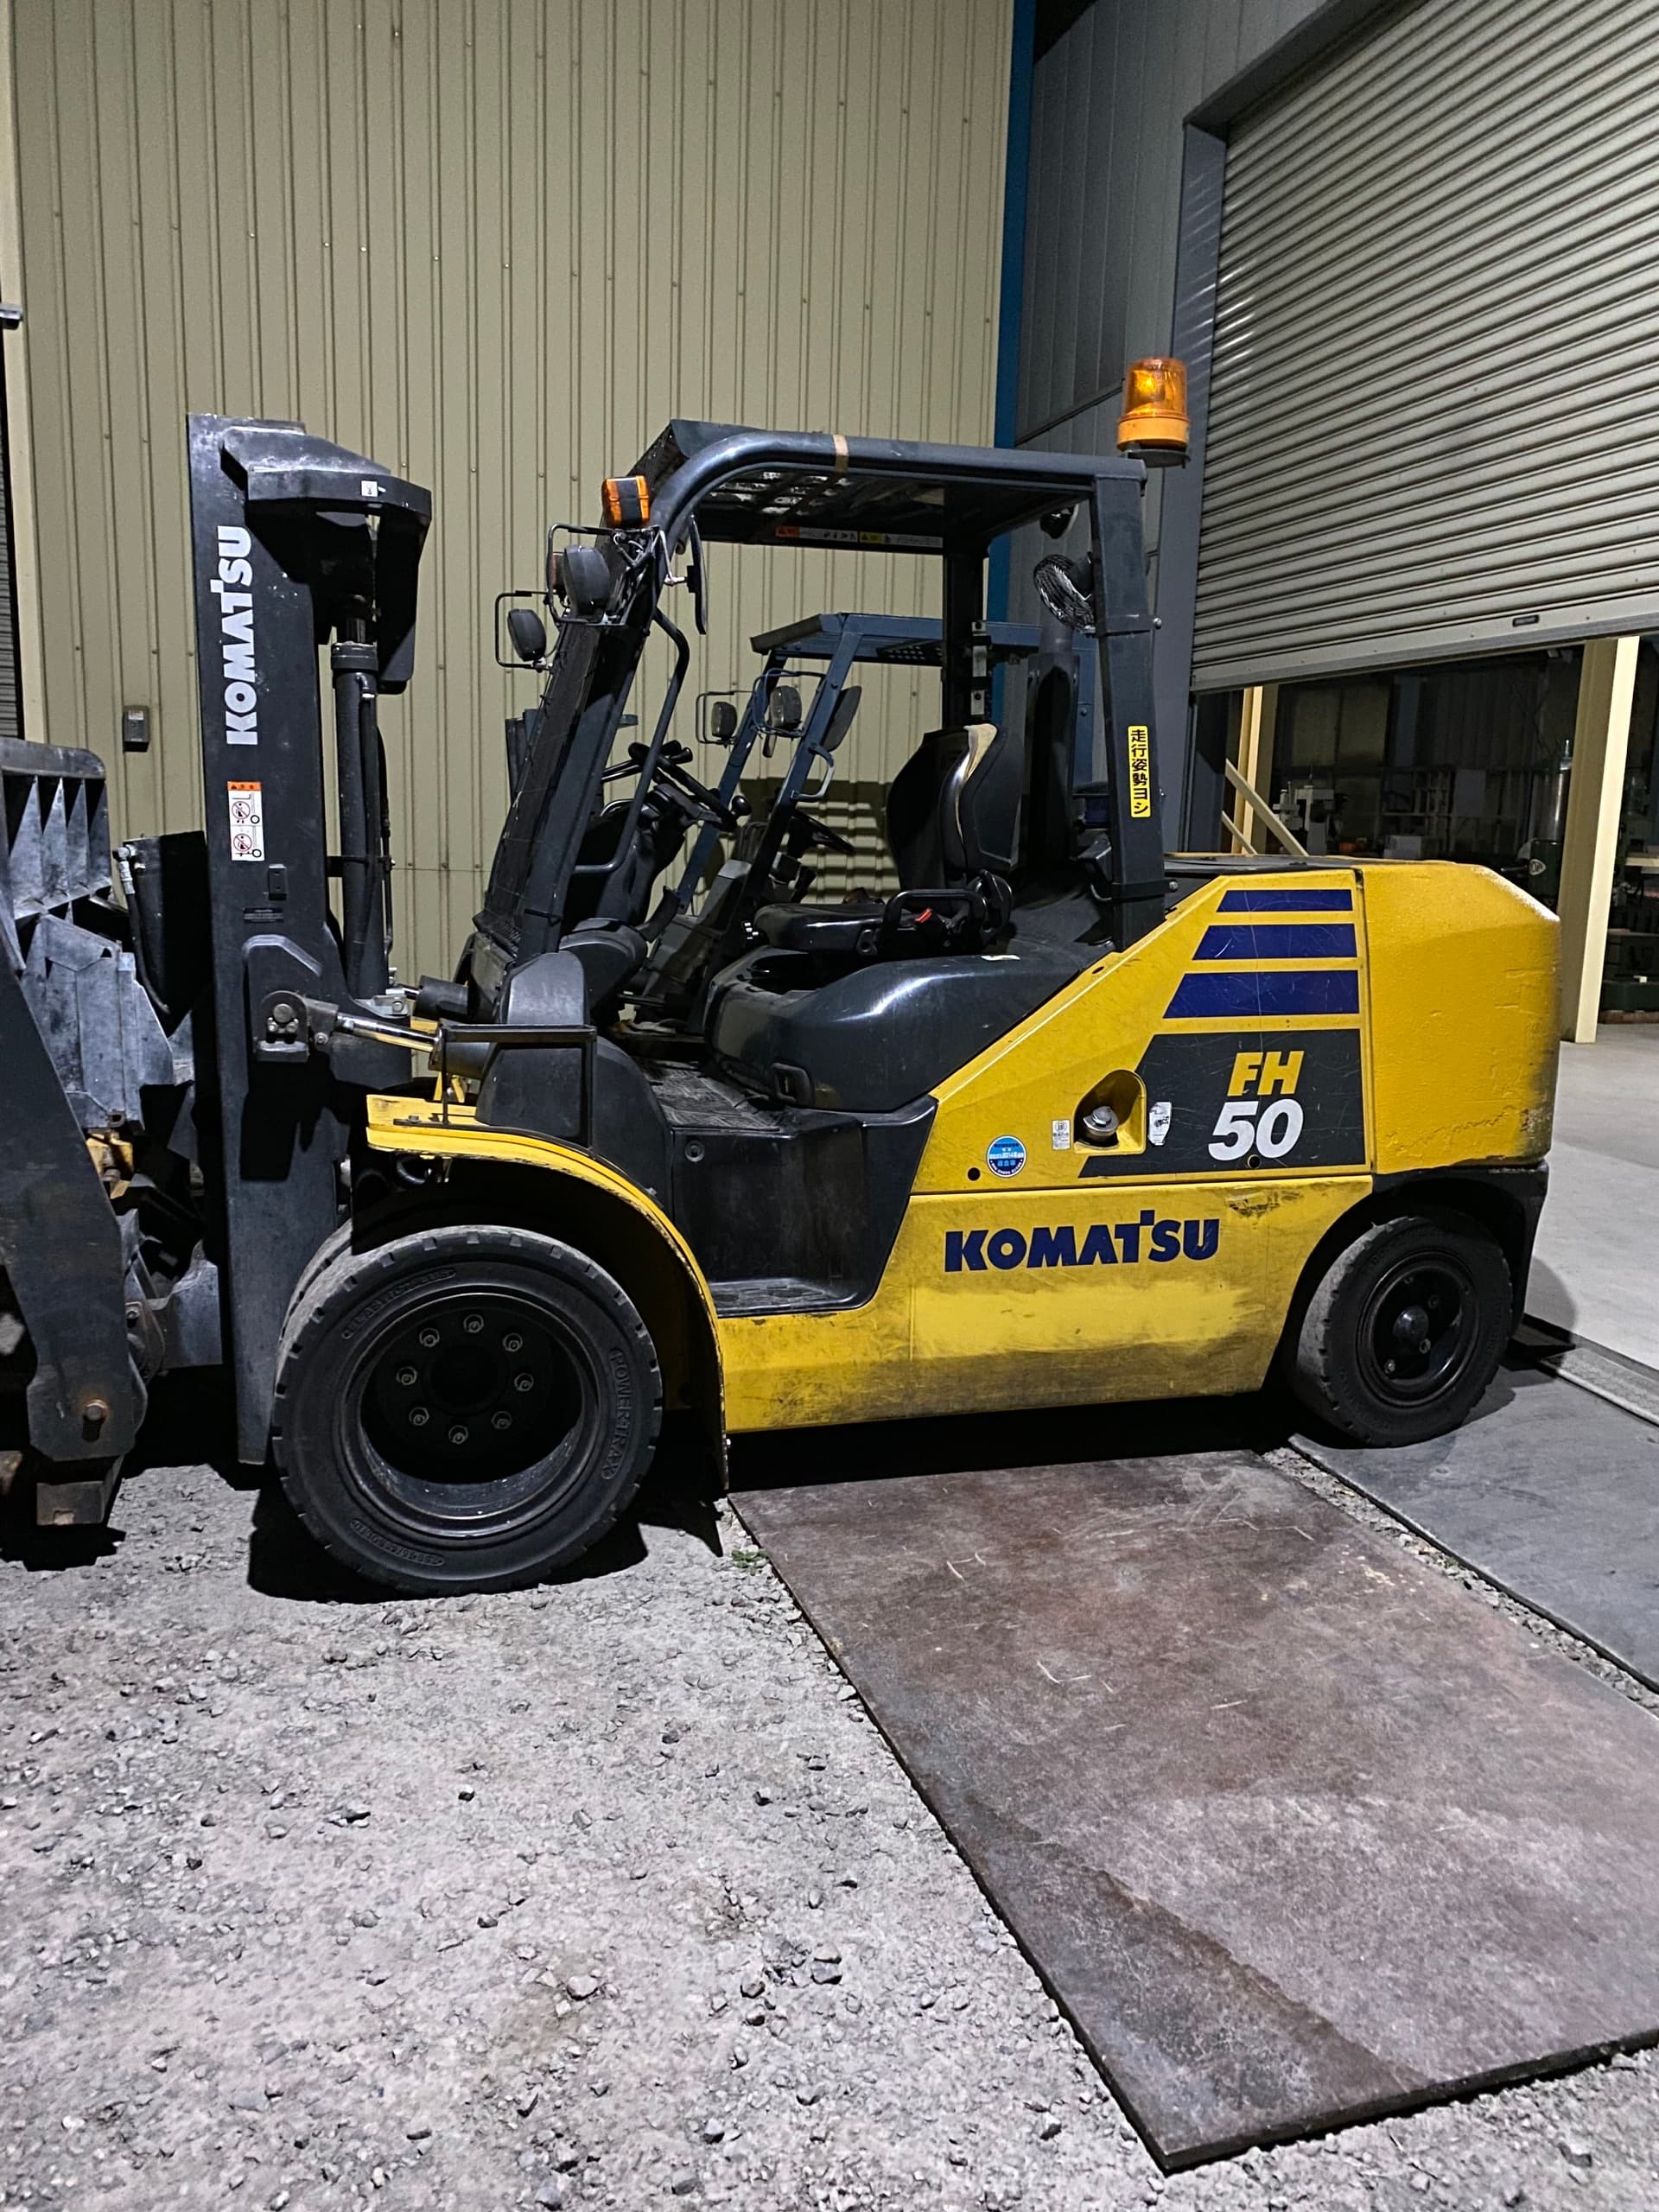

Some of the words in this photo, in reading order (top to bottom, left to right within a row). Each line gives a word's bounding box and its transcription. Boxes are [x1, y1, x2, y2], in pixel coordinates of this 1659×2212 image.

[210, 525, 258, 745] KOMATSU
[1130, 728, 1149, 815] 走行姿勢ヨシ
[1227, 1050, 1305, 1096] FH
[1208, 1098, 1304, 1161] 50
[944, 1210, 1220, 1273] KOMATSU
